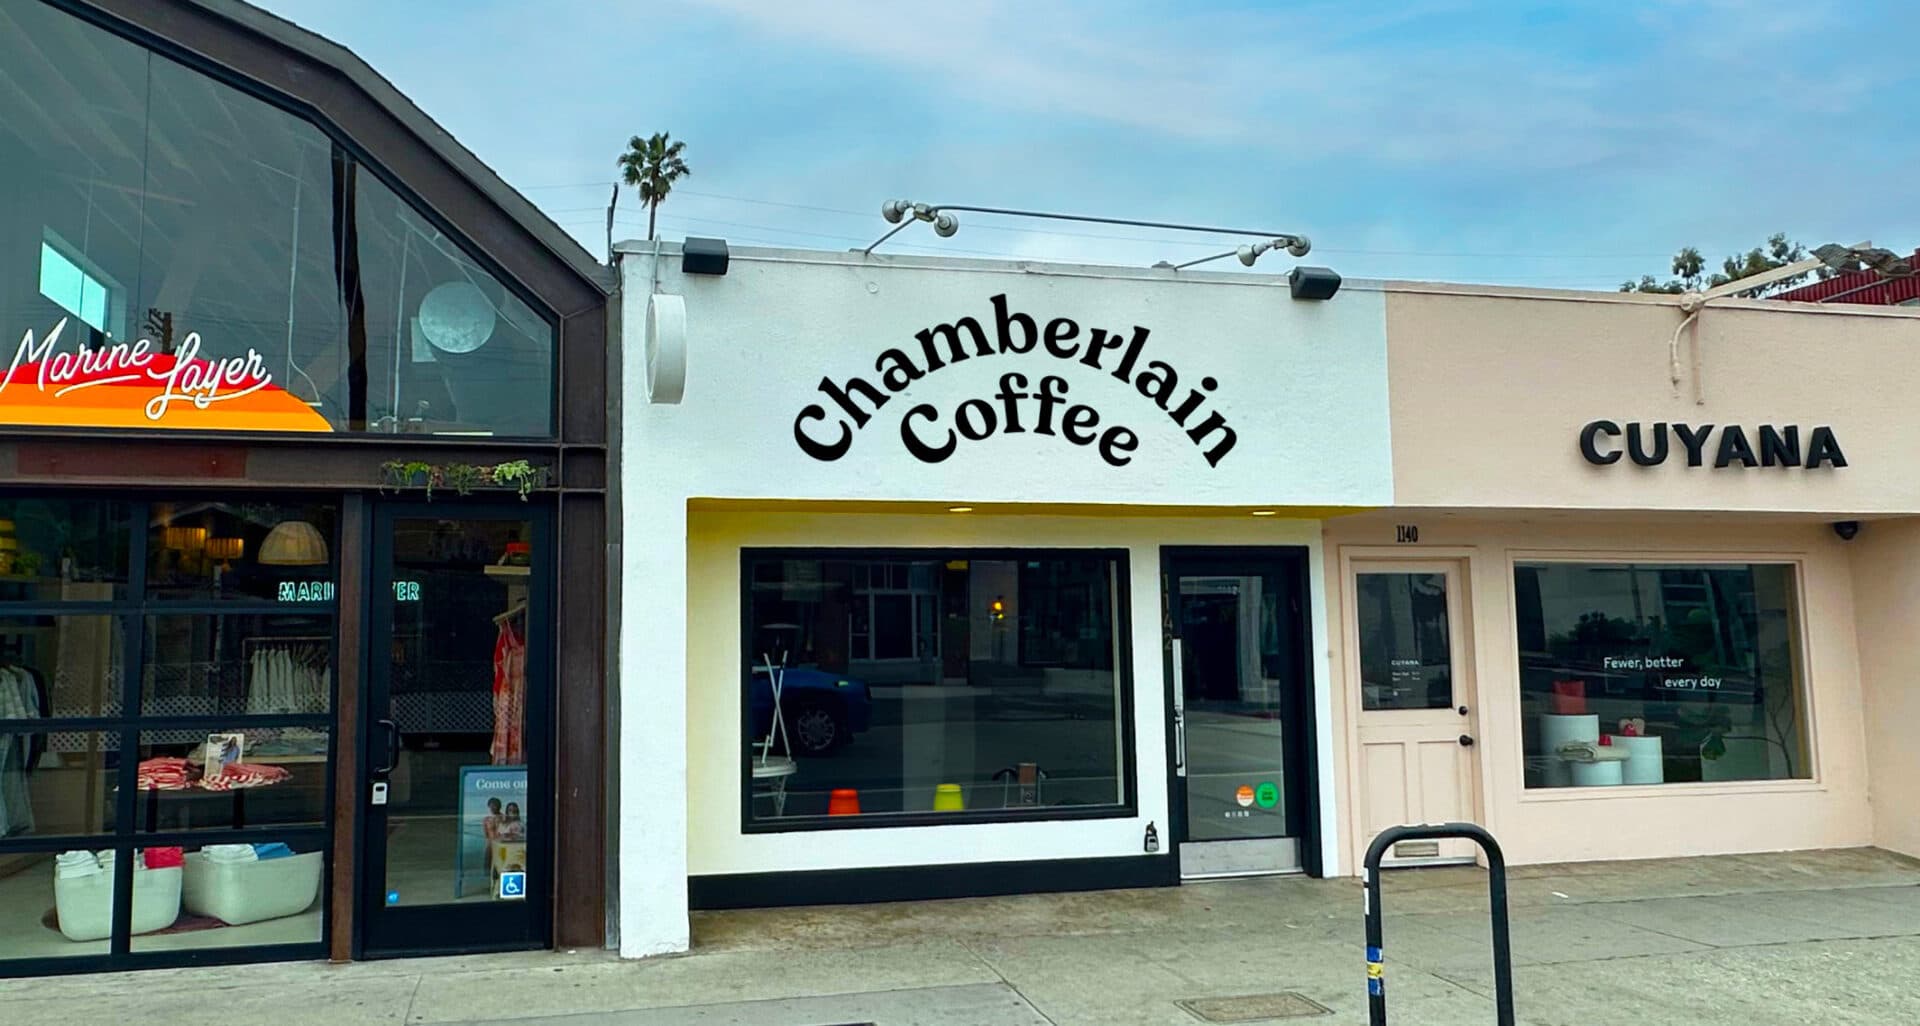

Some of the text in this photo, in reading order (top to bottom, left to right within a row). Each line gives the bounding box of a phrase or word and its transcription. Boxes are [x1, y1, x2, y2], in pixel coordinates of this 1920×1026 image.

[0, 316, 273, 420] Marine Layer
[794, 293, 1238, 468] Chamberlain
[900, 372, 1139, 467] Coffee
[1579, 420, 1848, 469] CUYANA
[1396, 524, 1419, 543] 1140
[278, 581, 420, 601] MARI ER
[1603, 656, 1684, 670] Fewer, better
[1664, 675, 1722, 691] every day
[475, 778, 511, 790] Come
